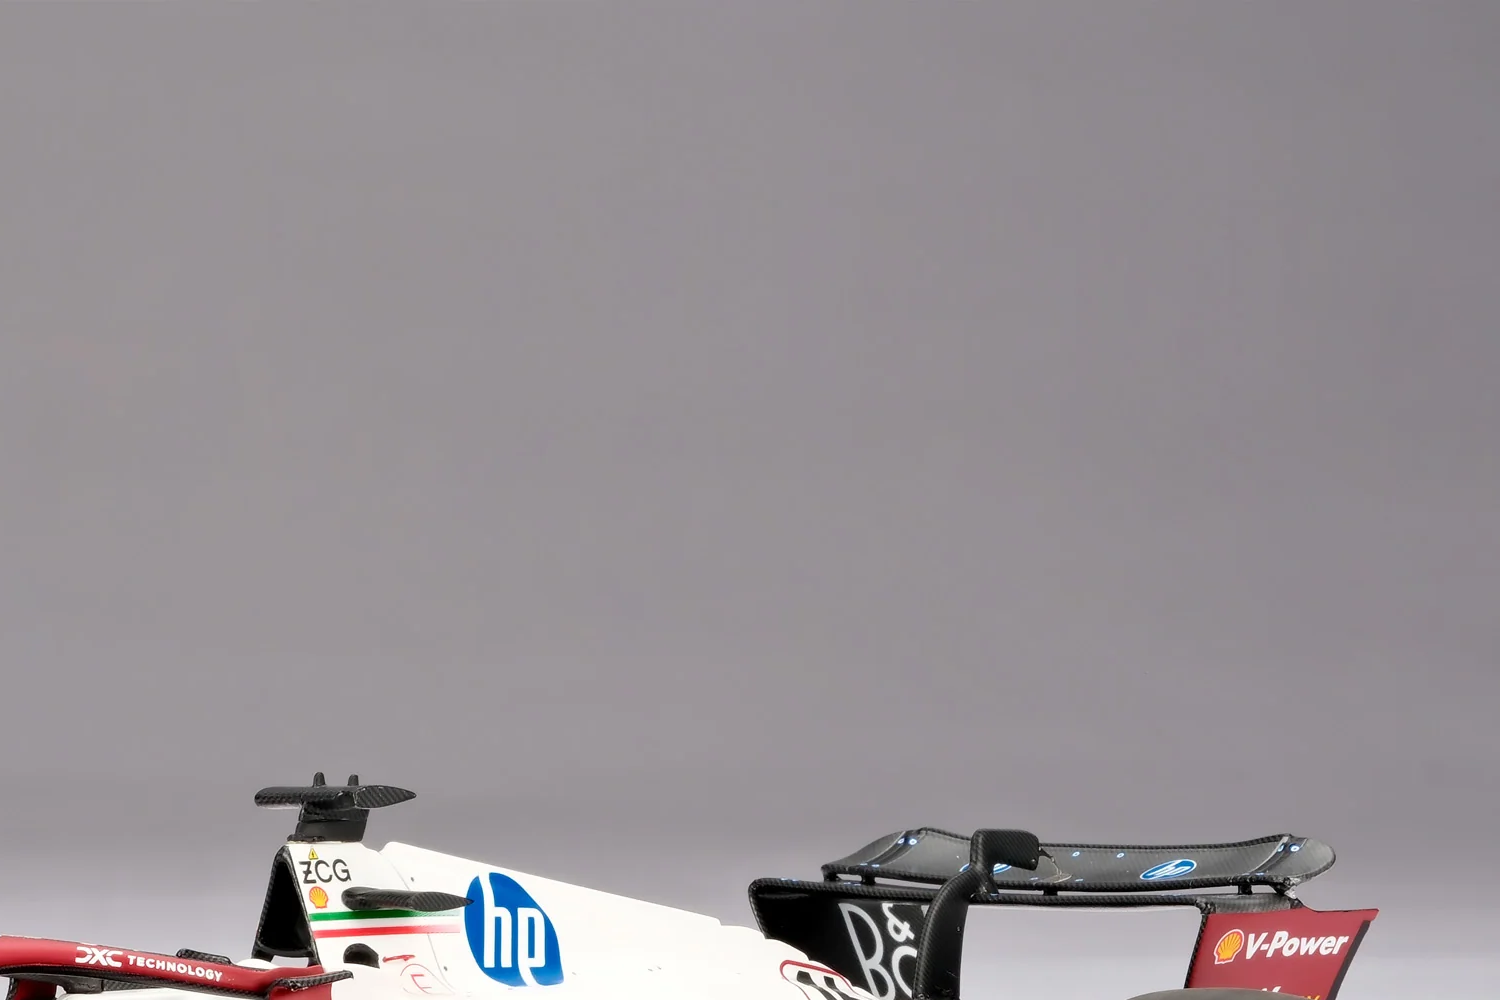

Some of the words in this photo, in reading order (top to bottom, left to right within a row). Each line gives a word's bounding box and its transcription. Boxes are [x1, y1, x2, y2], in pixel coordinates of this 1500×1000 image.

[478, 873, 546, 986] hp
[1245, 931, 1349, 959] V-Power
[75, 946, 124, 968] DXC
[127, 954, 223, 982] TECHNOLOGY
